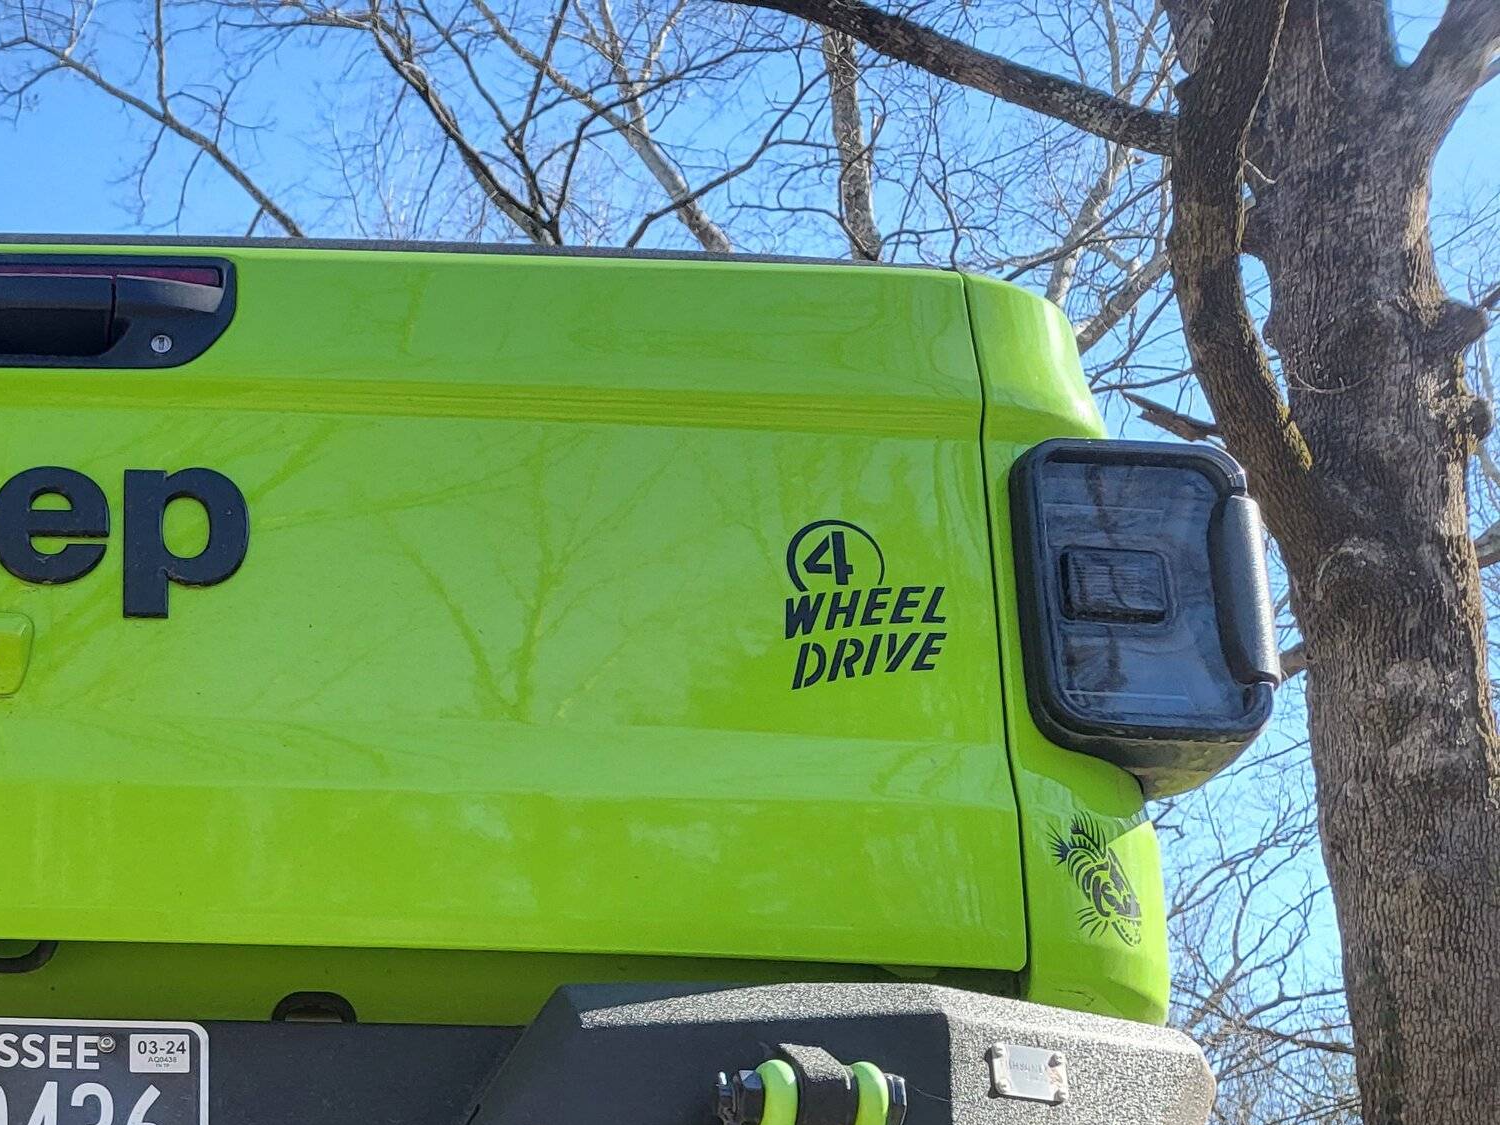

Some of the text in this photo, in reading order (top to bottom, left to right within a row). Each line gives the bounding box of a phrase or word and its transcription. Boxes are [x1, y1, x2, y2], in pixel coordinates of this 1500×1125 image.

[802, 530, 854, 587] 4
[784, 585, 947, 640] WHEEL
[791, 631, 948, 690] DRIVE
[137, 1040, 187, 1055] 03-24
